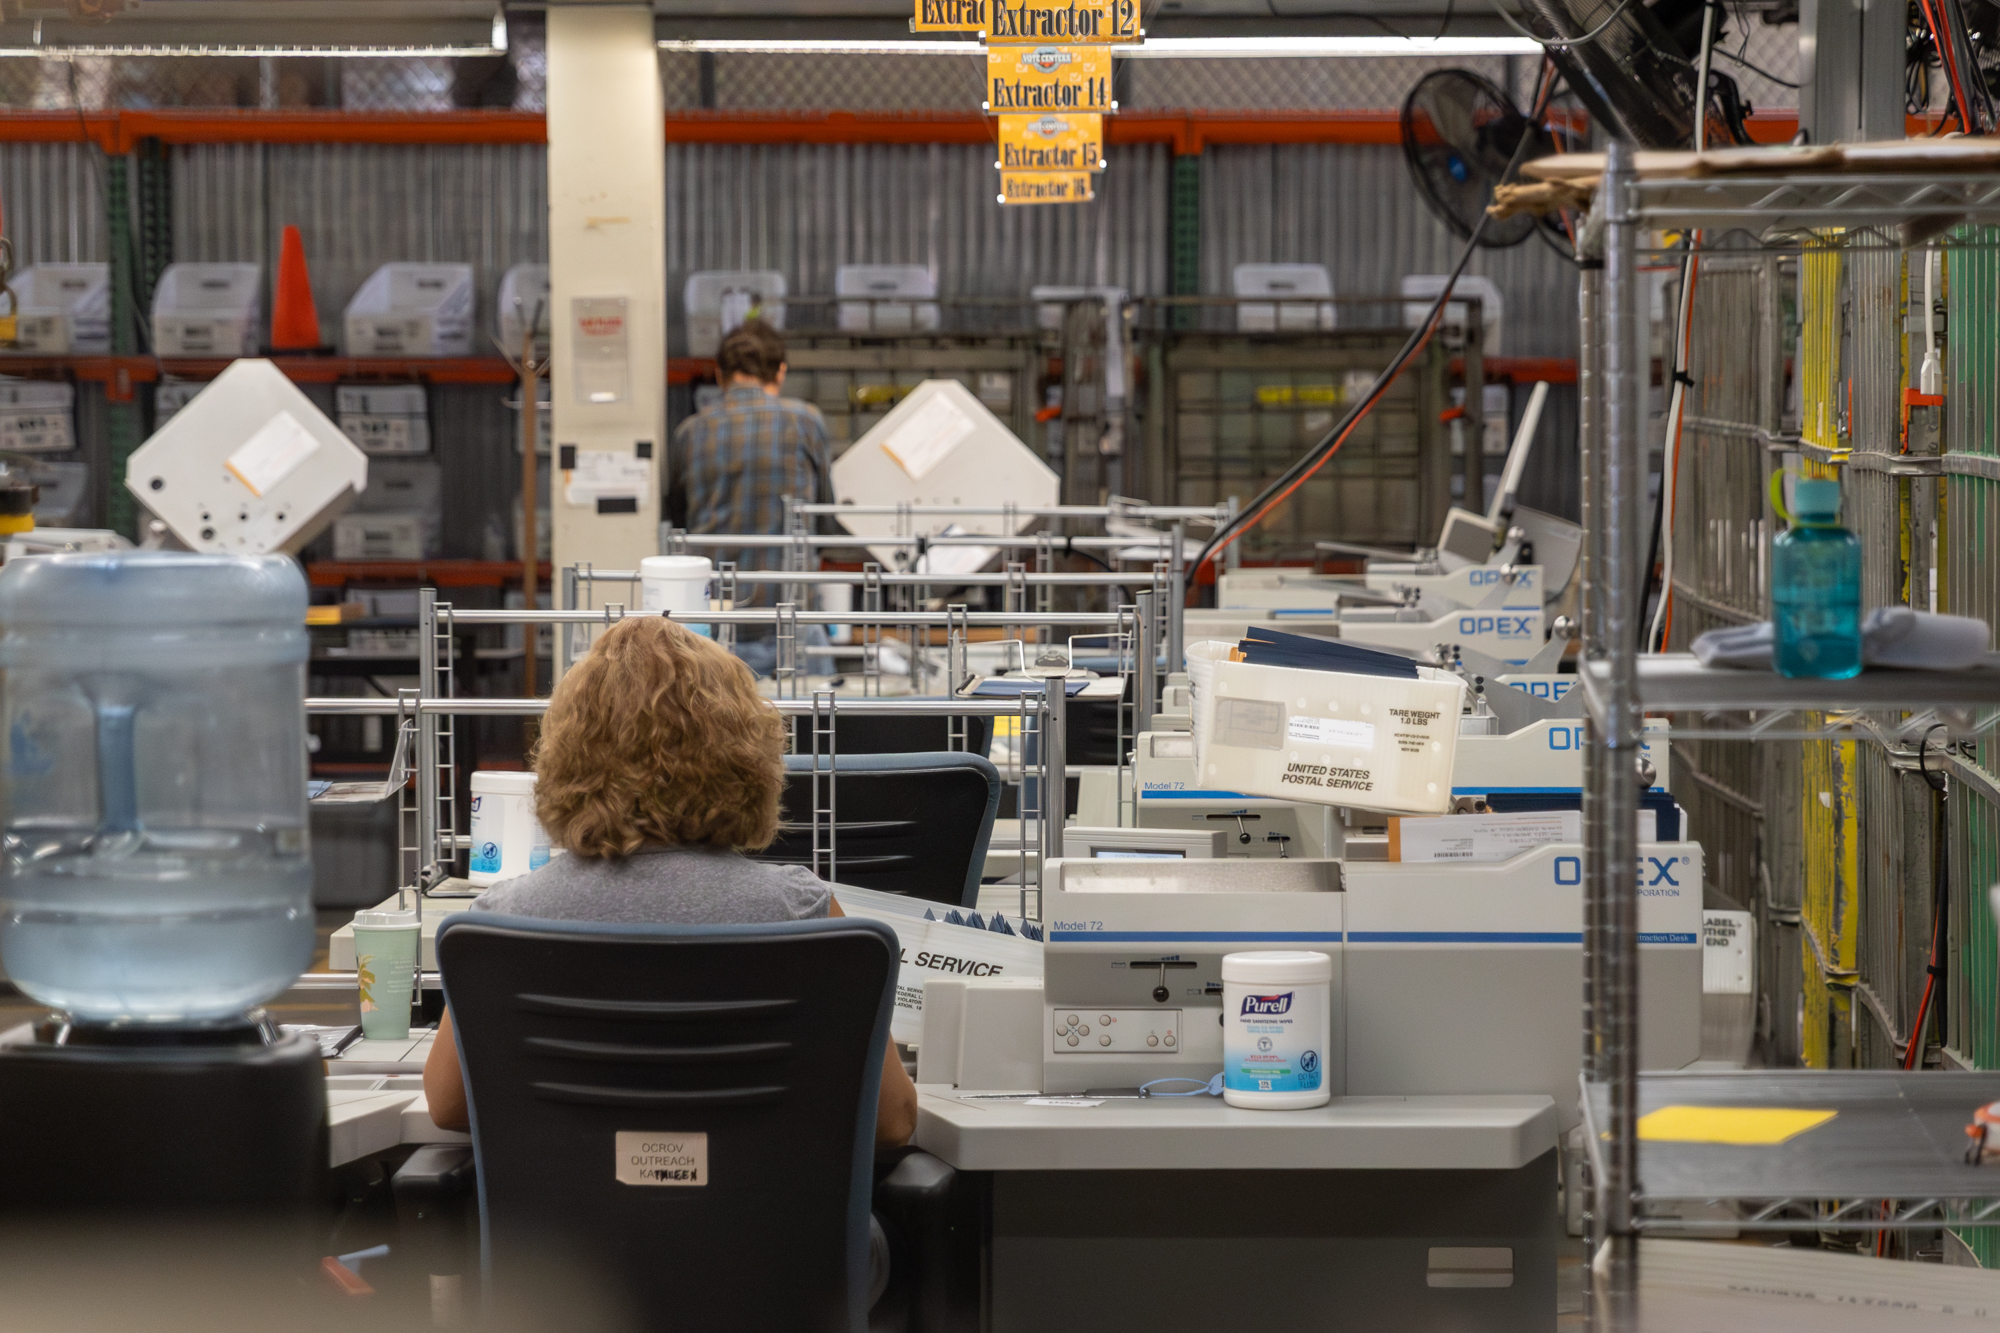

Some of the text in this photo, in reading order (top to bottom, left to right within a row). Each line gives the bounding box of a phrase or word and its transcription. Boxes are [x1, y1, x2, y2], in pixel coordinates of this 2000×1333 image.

[991, 0, 1134, 38] Extractor 12
[993, 77, 1106, 108] Extractor 14
[1004, 142, 1097, 167] Extractor 15
[1469, 570, 1532, 589] OPX
[1460, 617, 1531, 634] OPEX
[1389, 708, 1441, 719] TARE WEIGHT
[1400, 717, 1428, 726] 1.0 LBS
[1287, 763, 1371, 780] UNITED STATES
[1144, 782, 1185, 790] Model 72
[1281, 773, 1373, 791] POSTAL SERVICE
[1053, 921, 1104, 931] Model 72
[1637, 933, 1689, 942] traction Desk
[1705, 937, 1729, 947] END
[1245, 997, 1288, 1012] Purell
[641, 1142, 684, 1153] OCROV
[631, 1155, 695, 1166] OUTREACH
